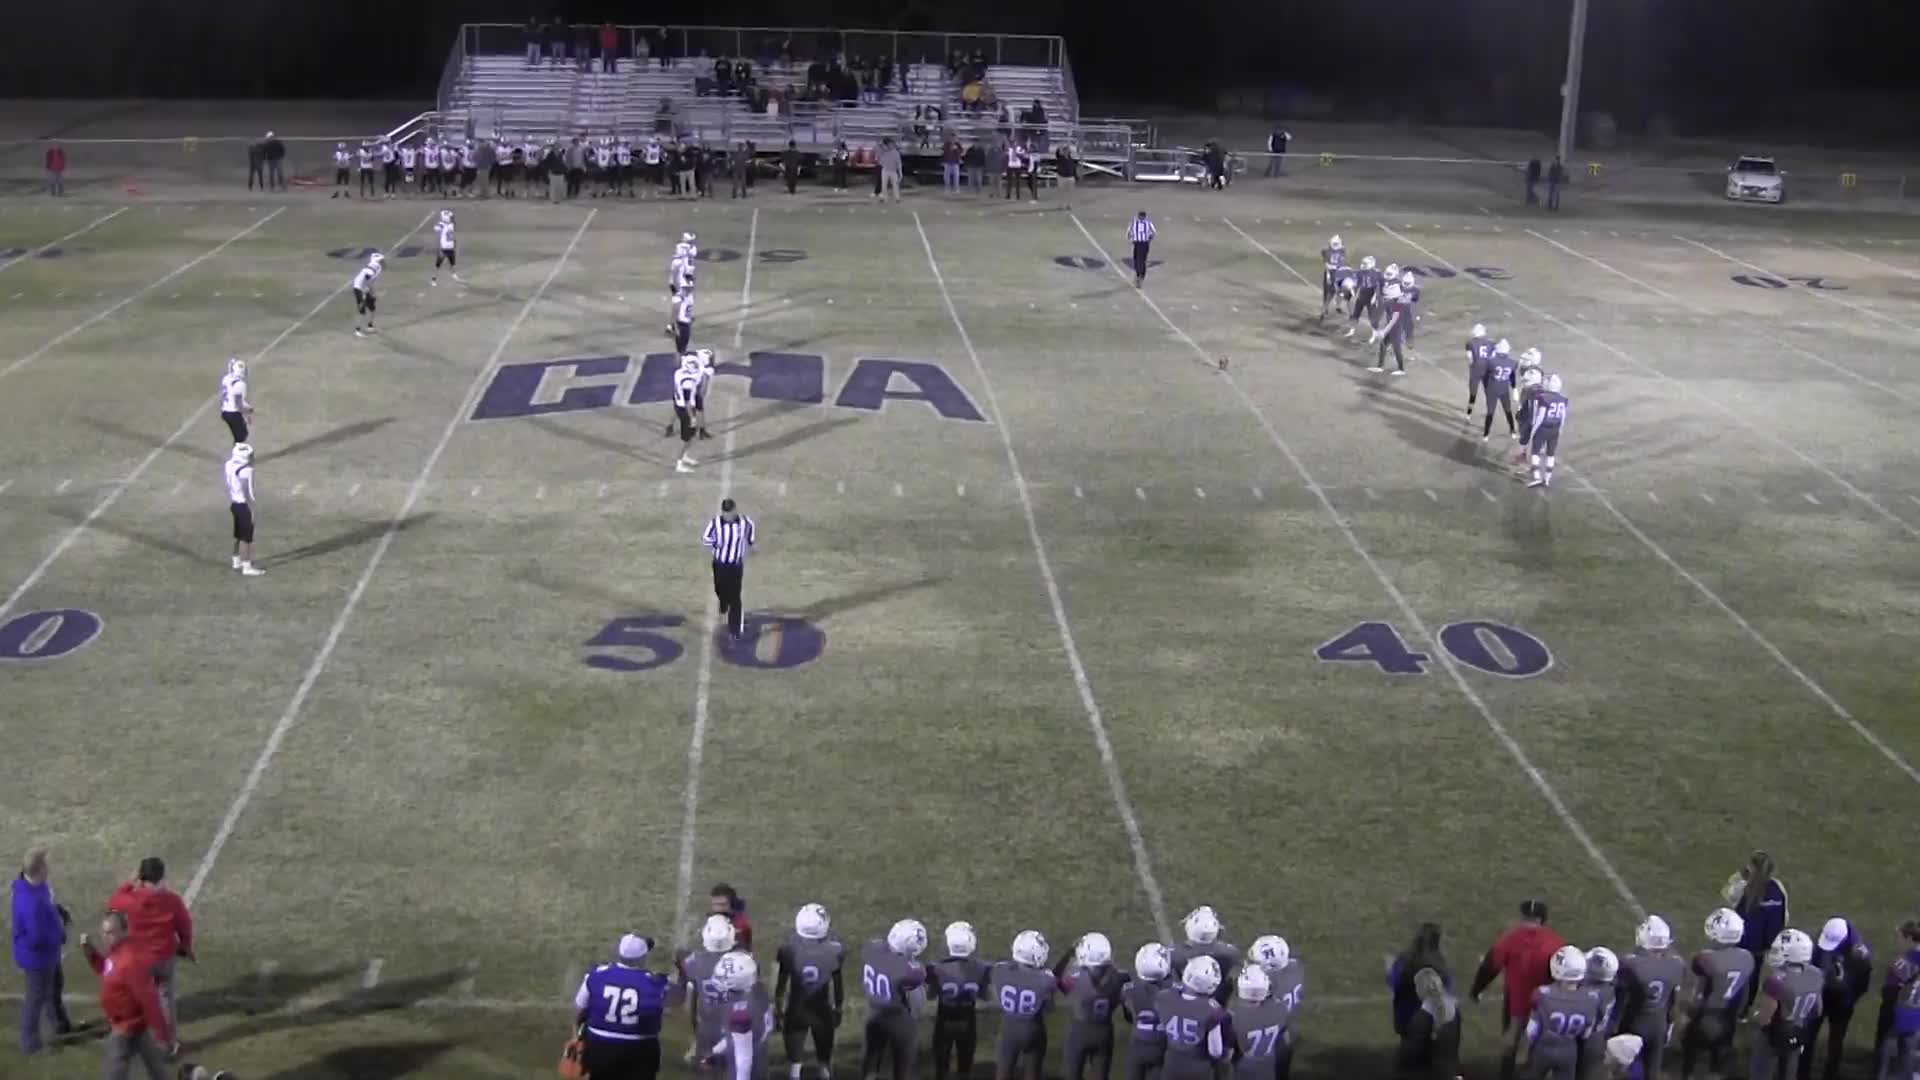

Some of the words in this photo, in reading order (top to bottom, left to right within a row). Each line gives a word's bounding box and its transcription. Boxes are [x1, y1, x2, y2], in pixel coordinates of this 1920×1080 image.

[469, 349, 991, 424] CHA
[582, 613, 828, 672] 50
[1313, 618, 1555, 678] 40
[863, 963, 892, 1001] 60
[1647, 980, 1665, 1004] 3
[1723, 971, 1742, 1000] 7
[602, 985, 640, 1025] 72
[1165, 1015, 1200, 1045] 45
[1246, 1024, 1280, 1057] 77
